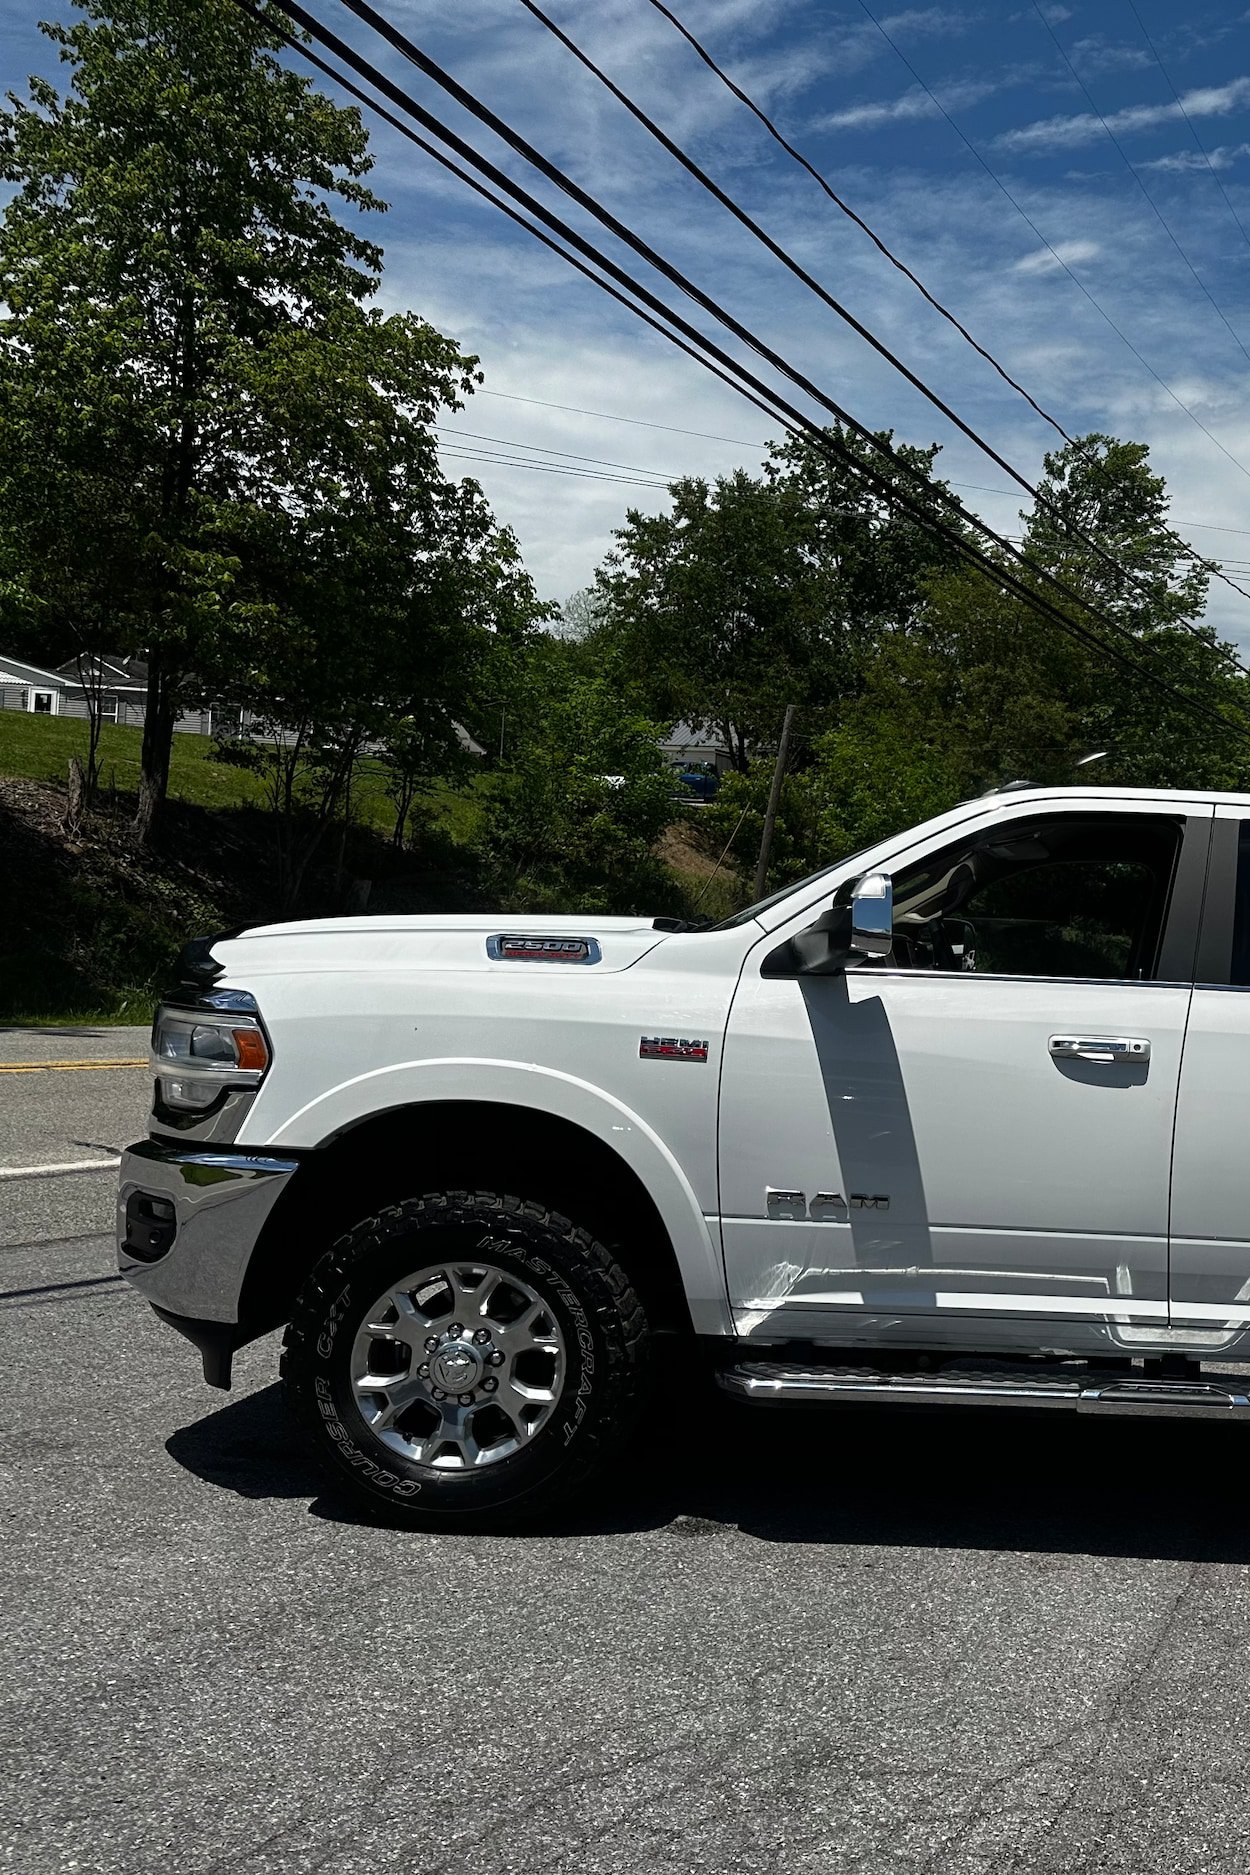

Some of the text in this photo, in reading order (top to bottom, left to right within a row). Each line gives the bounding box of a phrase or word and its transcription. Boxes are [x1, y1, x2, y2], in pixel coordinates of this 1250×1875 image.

[505, 940, 583, 953] 2500
[765, 1185, 890, 1212] RAM
[476, 1235, 595, 1446] MASTERCRAFT
[314, 1376, 422, 1497] COURSER
